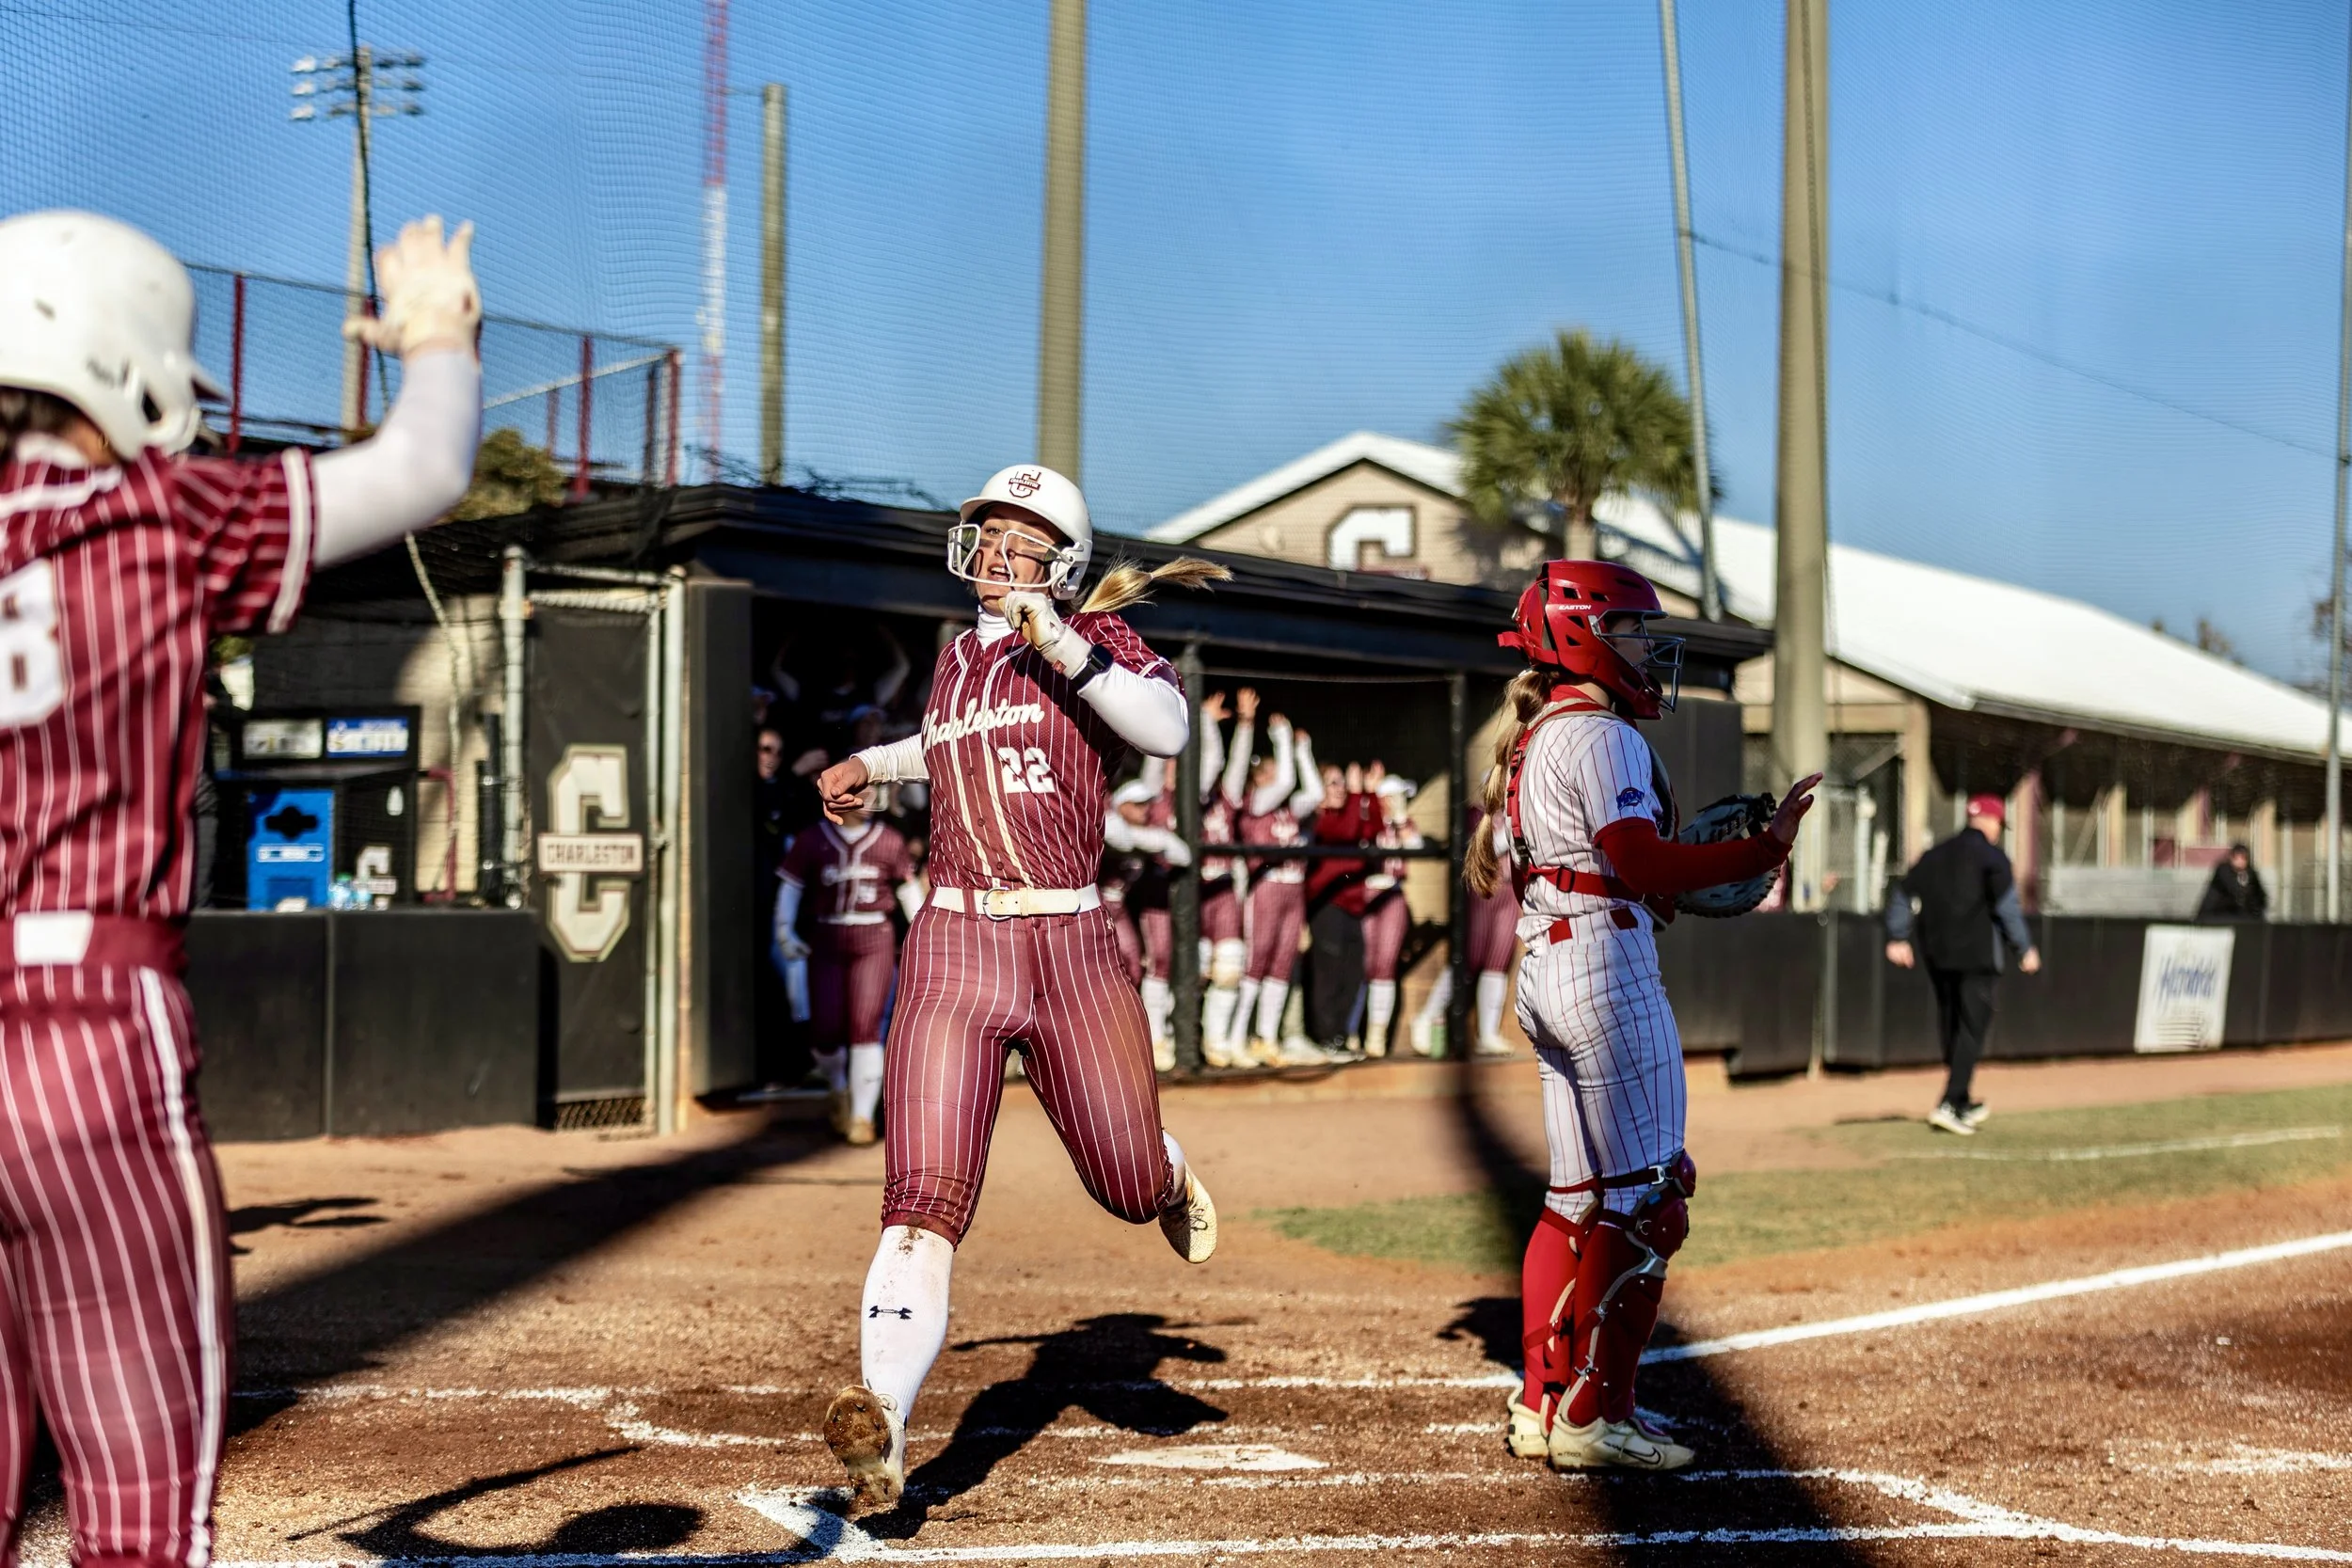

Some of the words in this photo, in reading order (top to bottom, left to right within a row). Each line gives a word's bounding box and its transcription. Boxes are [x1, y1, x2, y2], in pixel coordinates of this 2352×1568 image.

[997, 747, 1056, 793] 22
[546, 743, 630, 962] C
[547, 844, 635, 863] CHARLESTON
